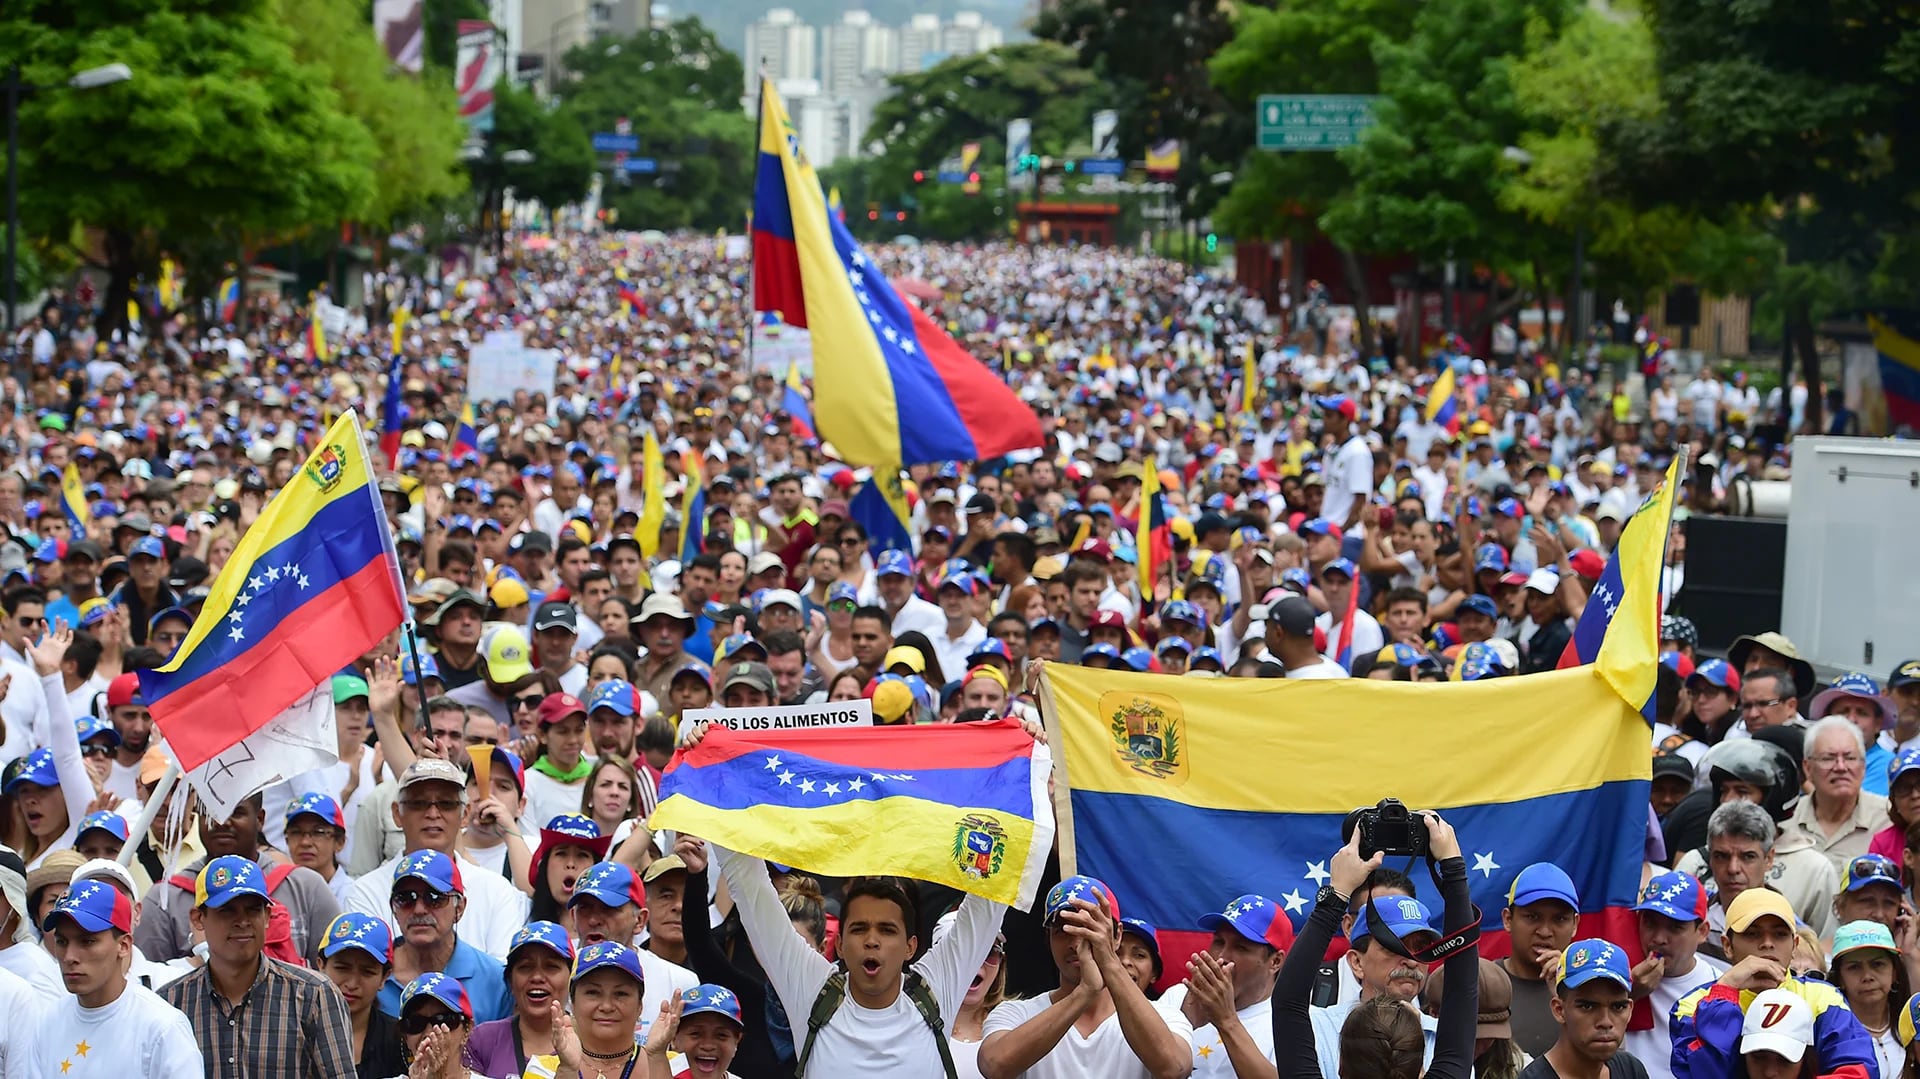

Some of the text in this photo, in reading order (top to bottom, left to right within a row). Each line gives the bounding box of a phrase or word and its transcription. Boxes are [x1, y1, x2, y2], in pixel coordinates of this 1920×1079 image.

[742, 716, 770, 730] LOS
[773, 710, 859, 729] ALIMENTOS
[1432, 936, 1465, 957] Canon
[1761, 1003, 1792, 1029] V
